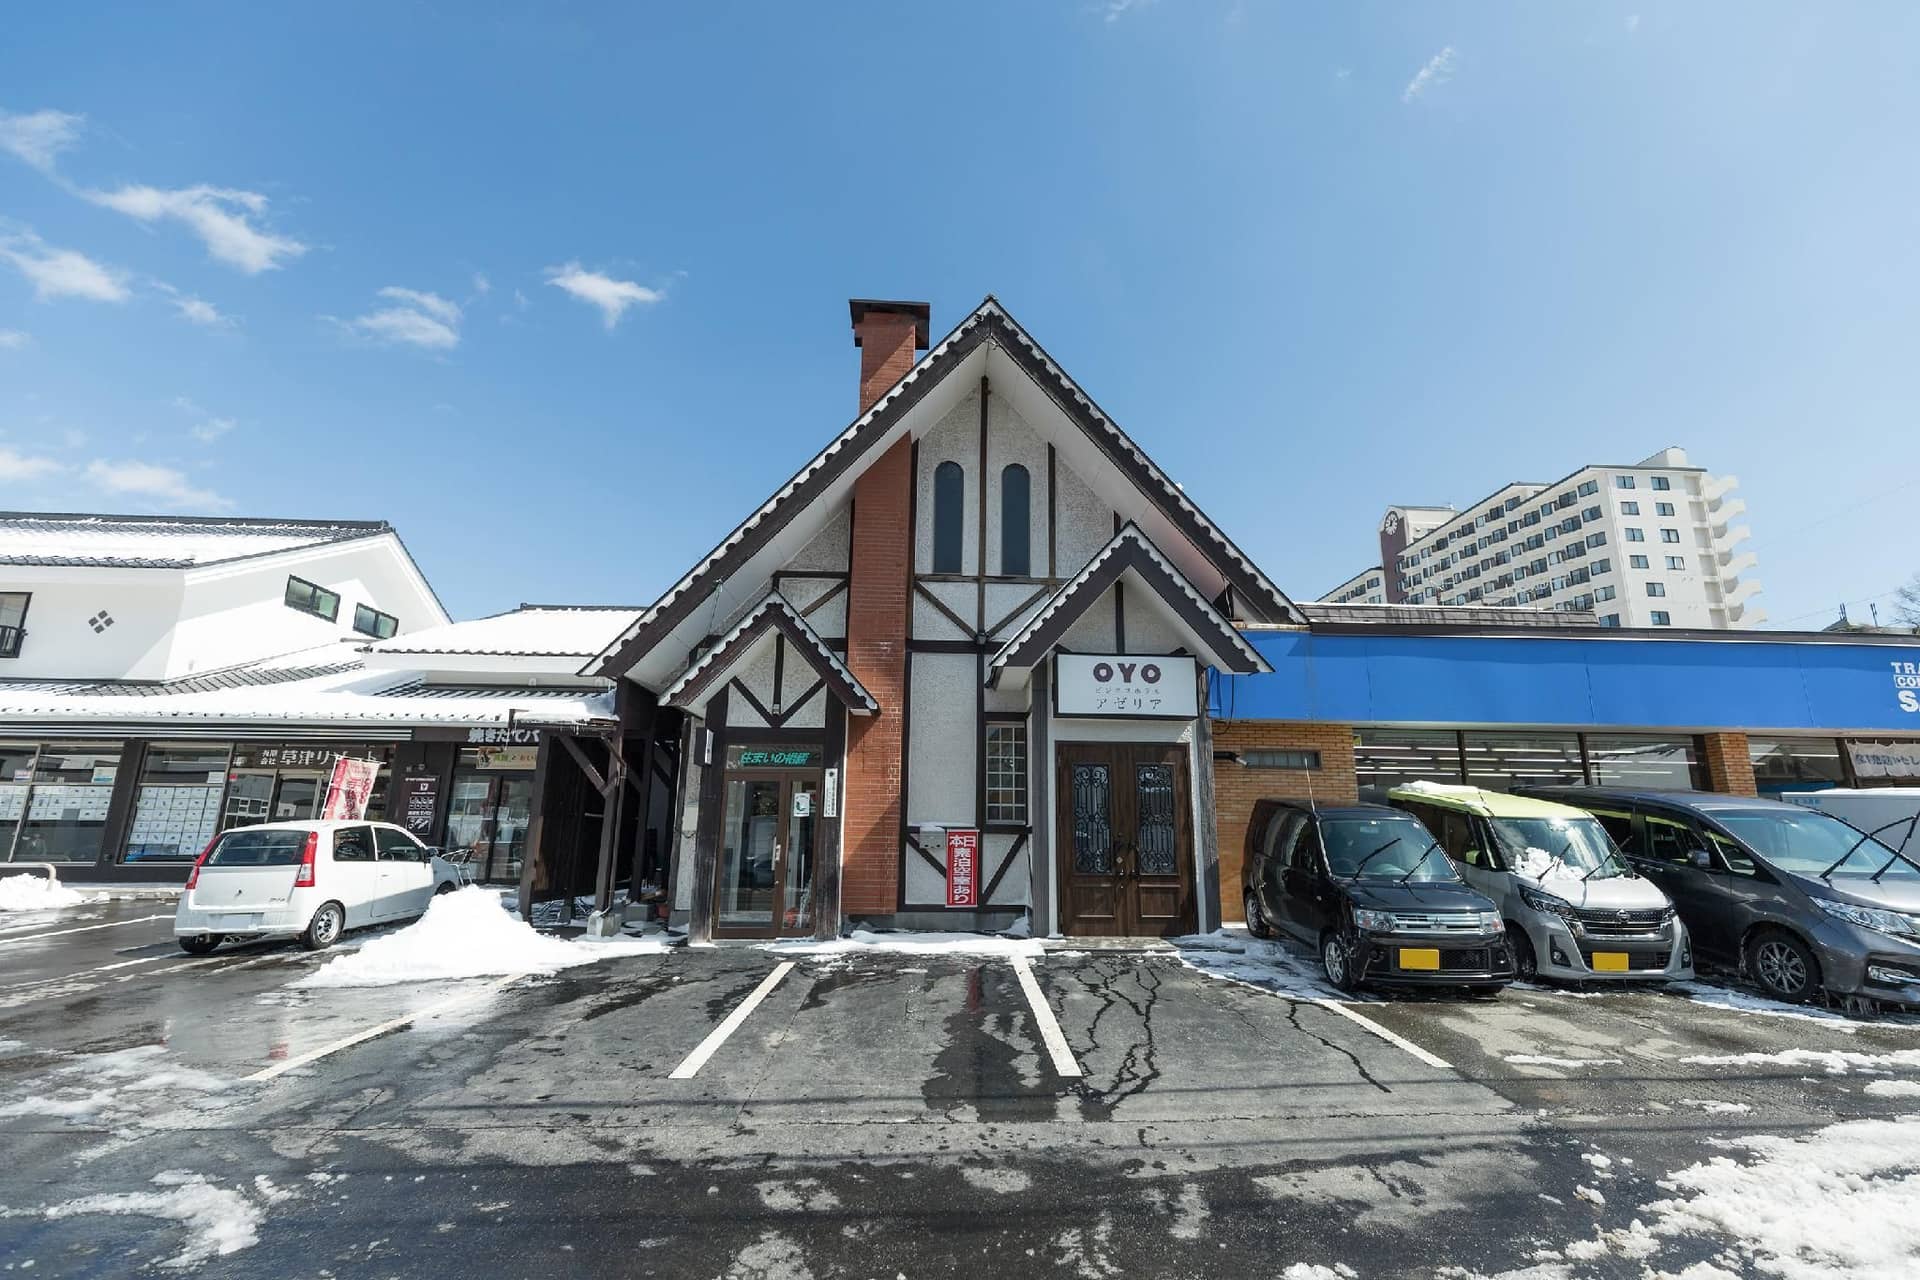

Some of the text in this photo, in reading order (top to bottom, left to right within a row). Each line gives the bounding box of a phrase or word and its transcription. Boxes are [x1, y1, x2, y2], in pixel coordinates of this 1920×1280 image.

[1093, 662, 1161, 684] OYO
[1097, 698, 1161, 710] アゼリア
[1898, 690, 1920, 713] S
[280, 750, 377, 766] 草津リト
[949, 834, 977, 848] 本日
